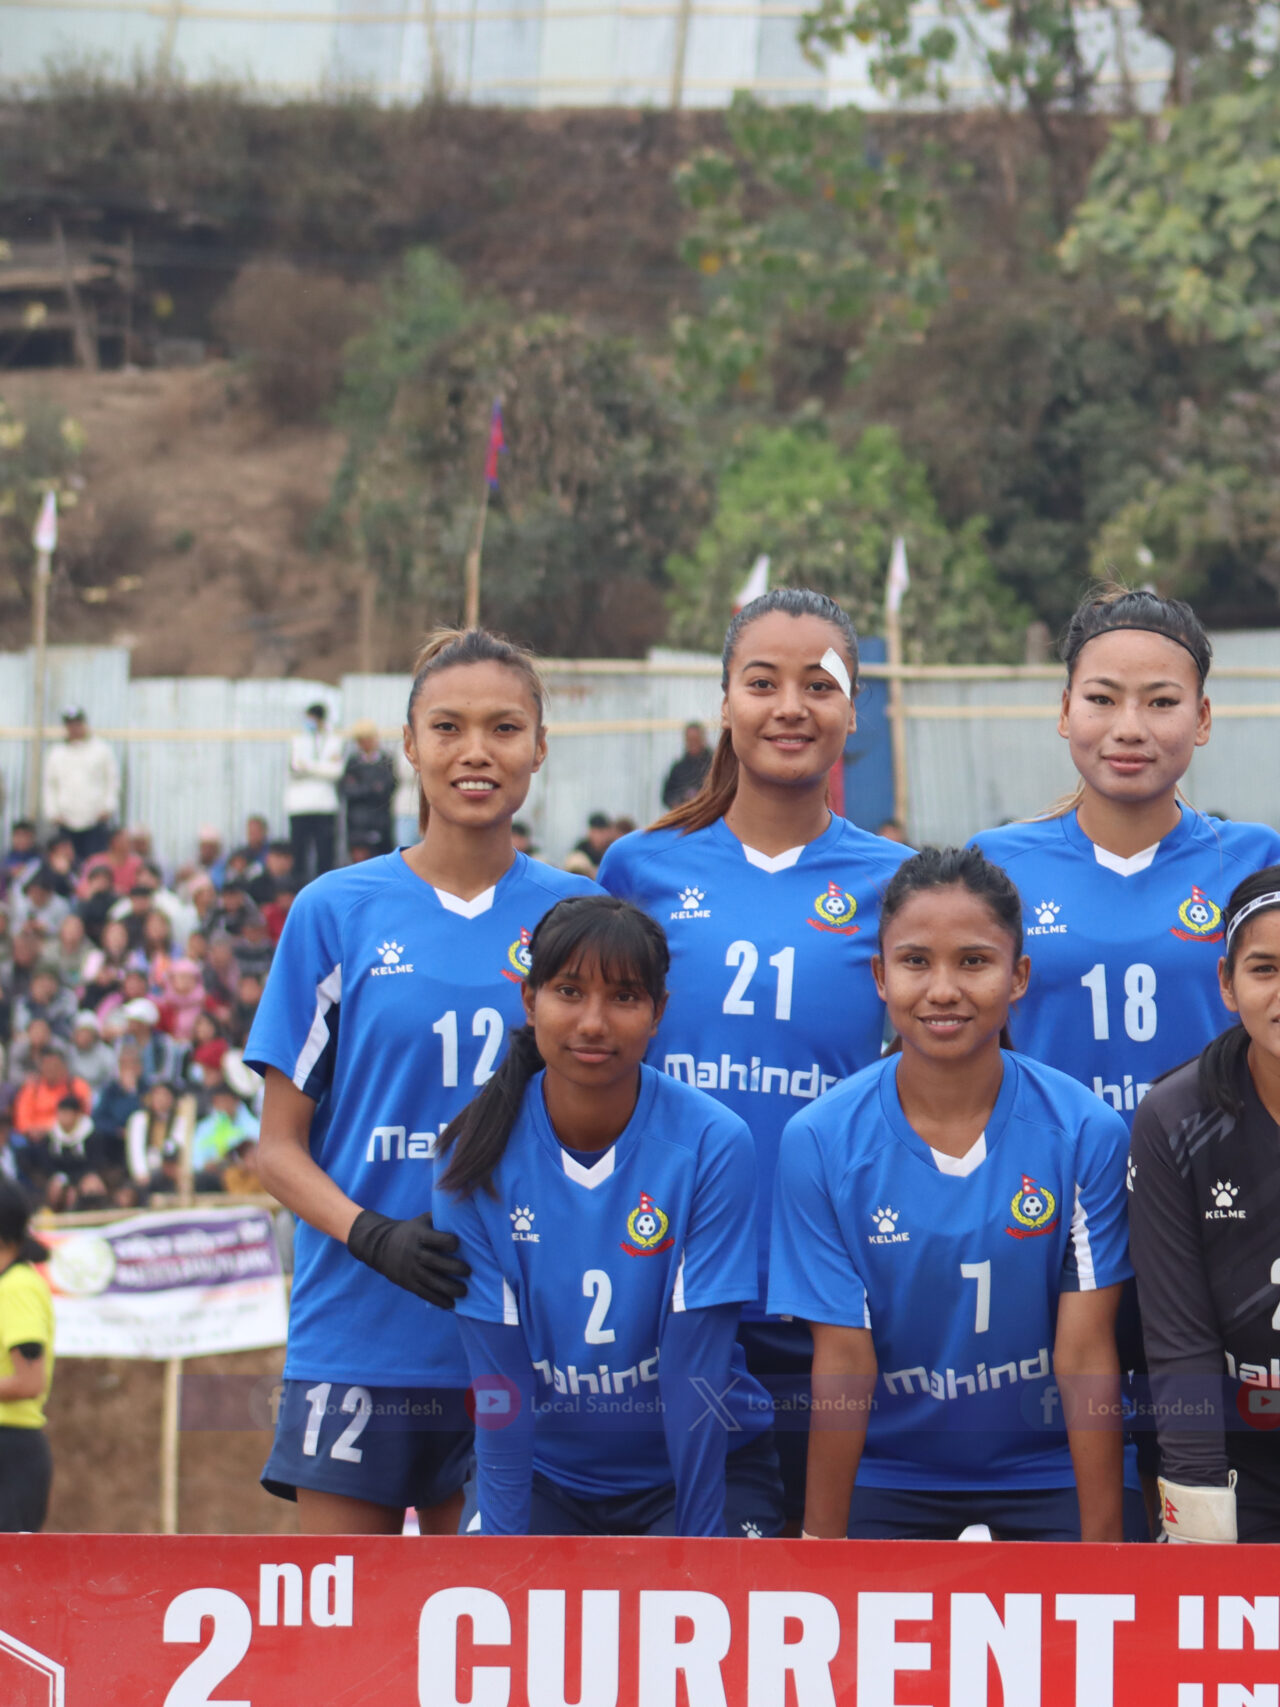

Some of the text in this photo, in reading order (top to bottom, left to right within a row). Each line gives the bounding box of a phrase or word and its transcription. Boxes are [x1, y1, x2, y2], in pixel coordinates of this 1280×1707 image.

[670, 910, 711, 920] KELME
[1027, 924, 1068, 936] KELME
[371, 964, 414, 976] KELME
[722, 940, 795, 1020] 21
[1081, 963, 1157, 1042] 18
[432, 1007, 504, 1087] 12
[512, 1232, 540, 1243] ELME
[868, 1232, 910, 1244] KELME
[1205, 1209, 1247, 1219] KELME
[582, 1269, 616, 1345] 2
[960, 1259, 991, 1334] 7
[303, 1382, 373, 1464] 12
[162, 1555, 1136, 1707] 2nd CURRENT
